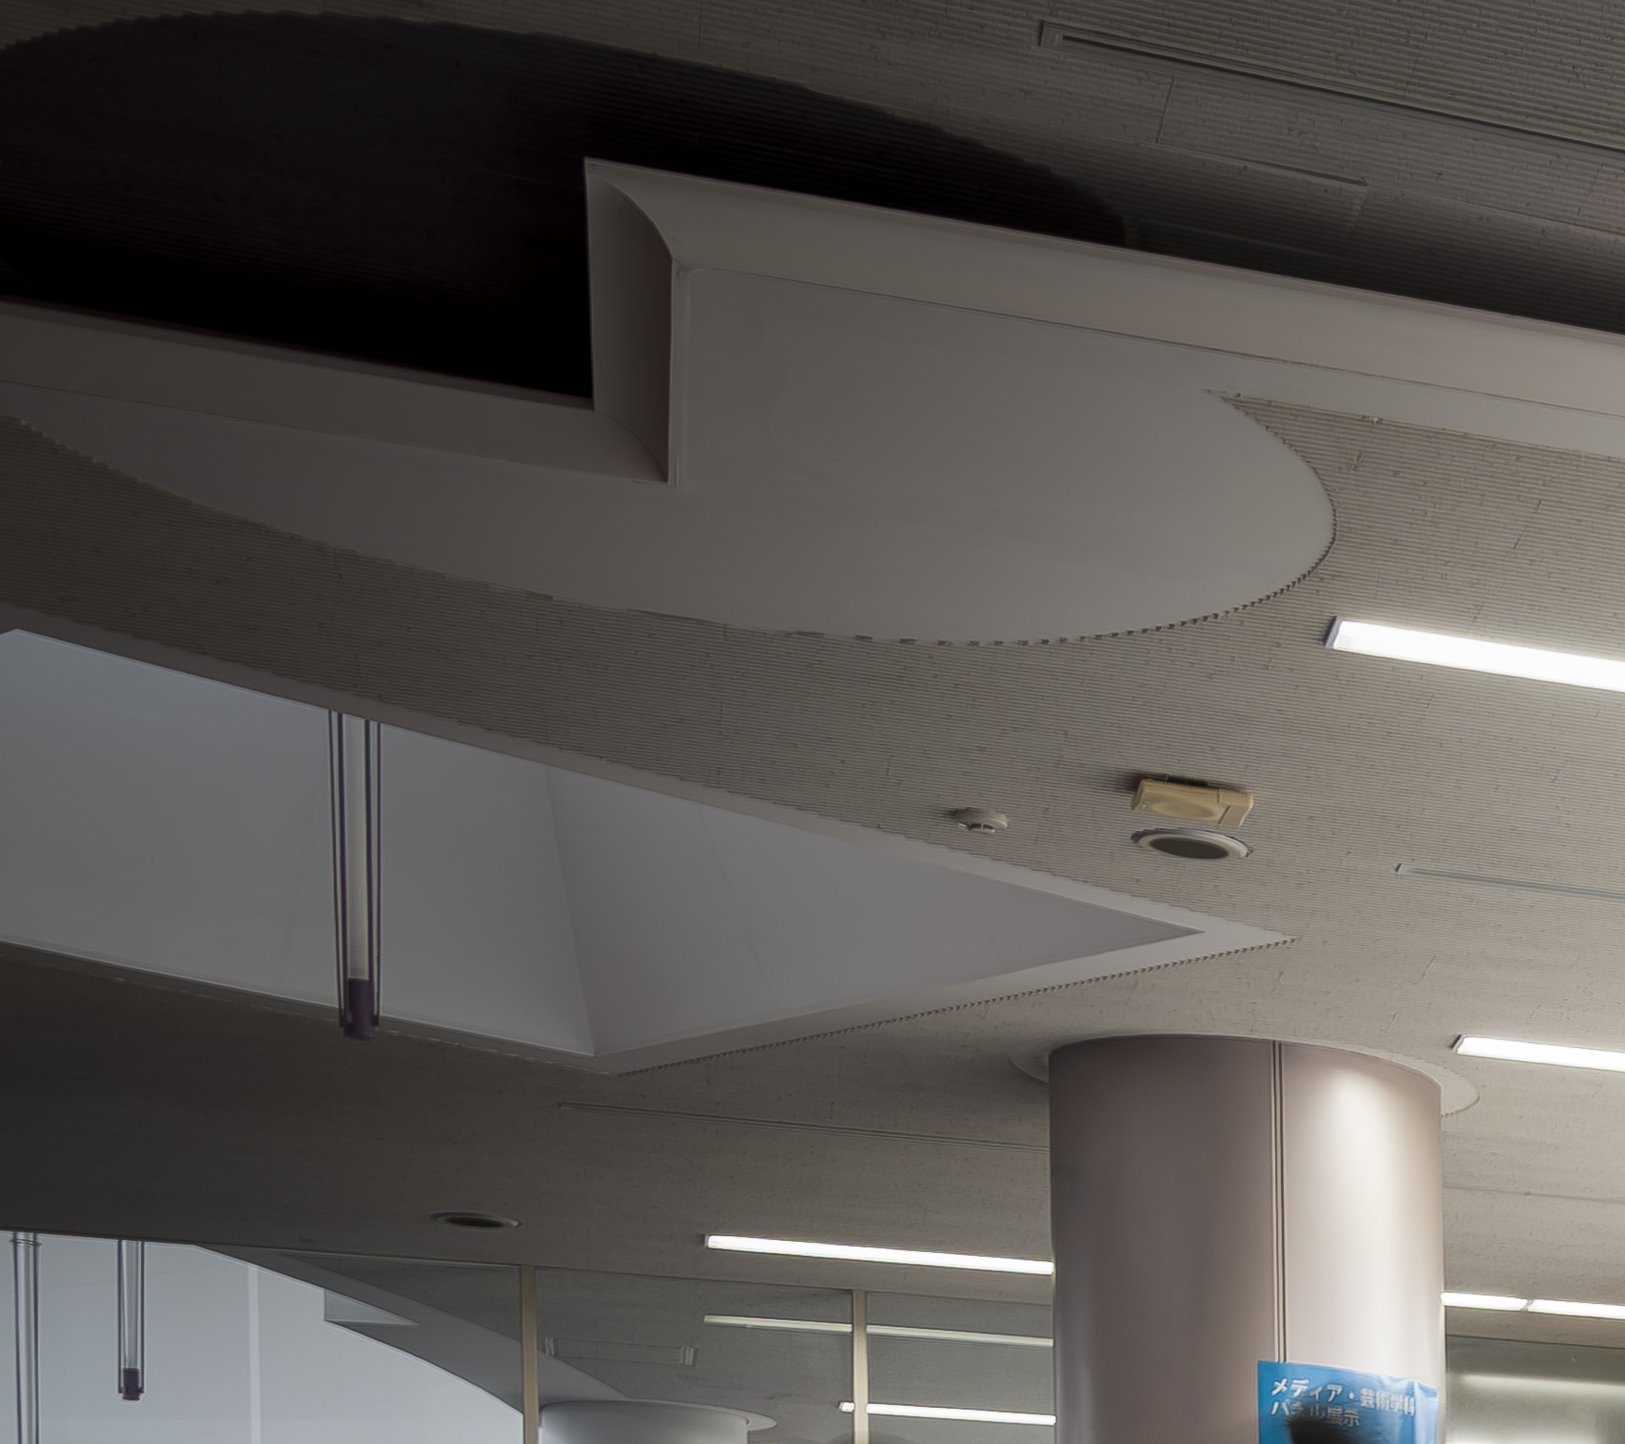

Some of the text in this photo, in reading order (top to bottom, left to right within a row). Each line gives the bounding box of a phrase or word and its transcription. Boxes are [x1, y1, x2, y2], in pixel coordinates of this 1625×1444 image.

[1271, 1377, 1415, 1417] メディア・芸術学科
